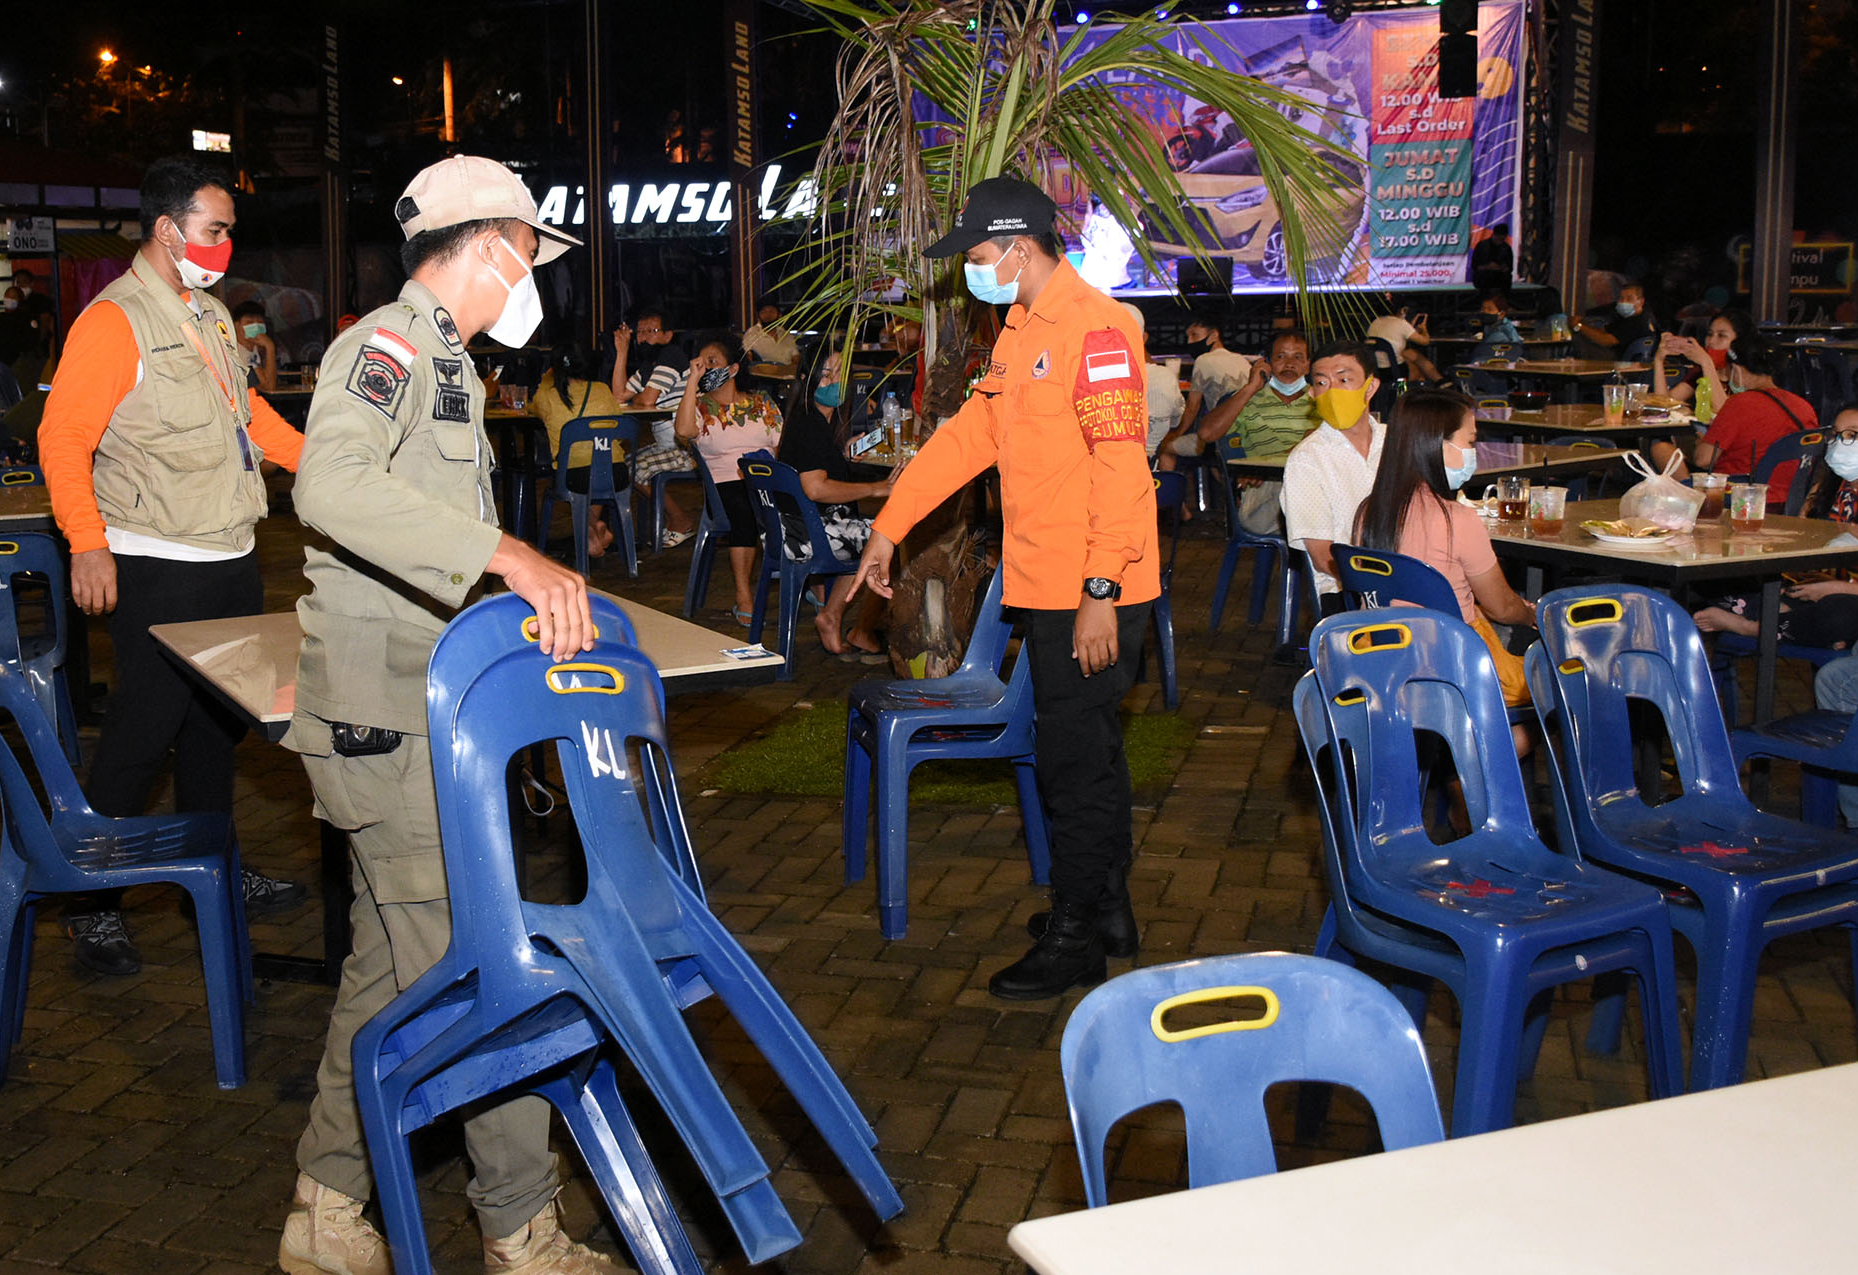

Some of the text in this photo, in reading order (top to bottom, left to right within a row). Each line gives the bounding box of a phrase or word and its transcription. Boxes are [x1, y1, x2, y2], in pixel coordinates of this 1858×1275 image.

[1566, 0, 1594, 134] KATAMSO LA
[1381, 71, 1439, 91] KAM
[731, 21, 752, 168] KATAMSO LAND
[1380, 93, 1423, 107] 12.00
[1409, 105, 1433, 118] s.d
[1377, 118, 1467, 135] Last Order
[1384, 147, 1459, 168] JUMAT
[1377, 181, 1465, 201] MINGGU
[537, 181, 733, 225] AAMSO
[1379, 204, 1461, 221] 12.00 WIB
[1408, 220, 1432, 234] s.d
[1379, 232, 1460, 249] 17.00 WIB
[1791, 247, 1824, 264] tival
[1380, 269, 1417, 278] Minimal
[1790, 275, 1819, 288] mpu
[1075, 388, 1143, 412] PENGAWA
[594, 435, 611, 451] KL
[757, 488, 775, 508] KL
[580, 719, 626, 780] KL
